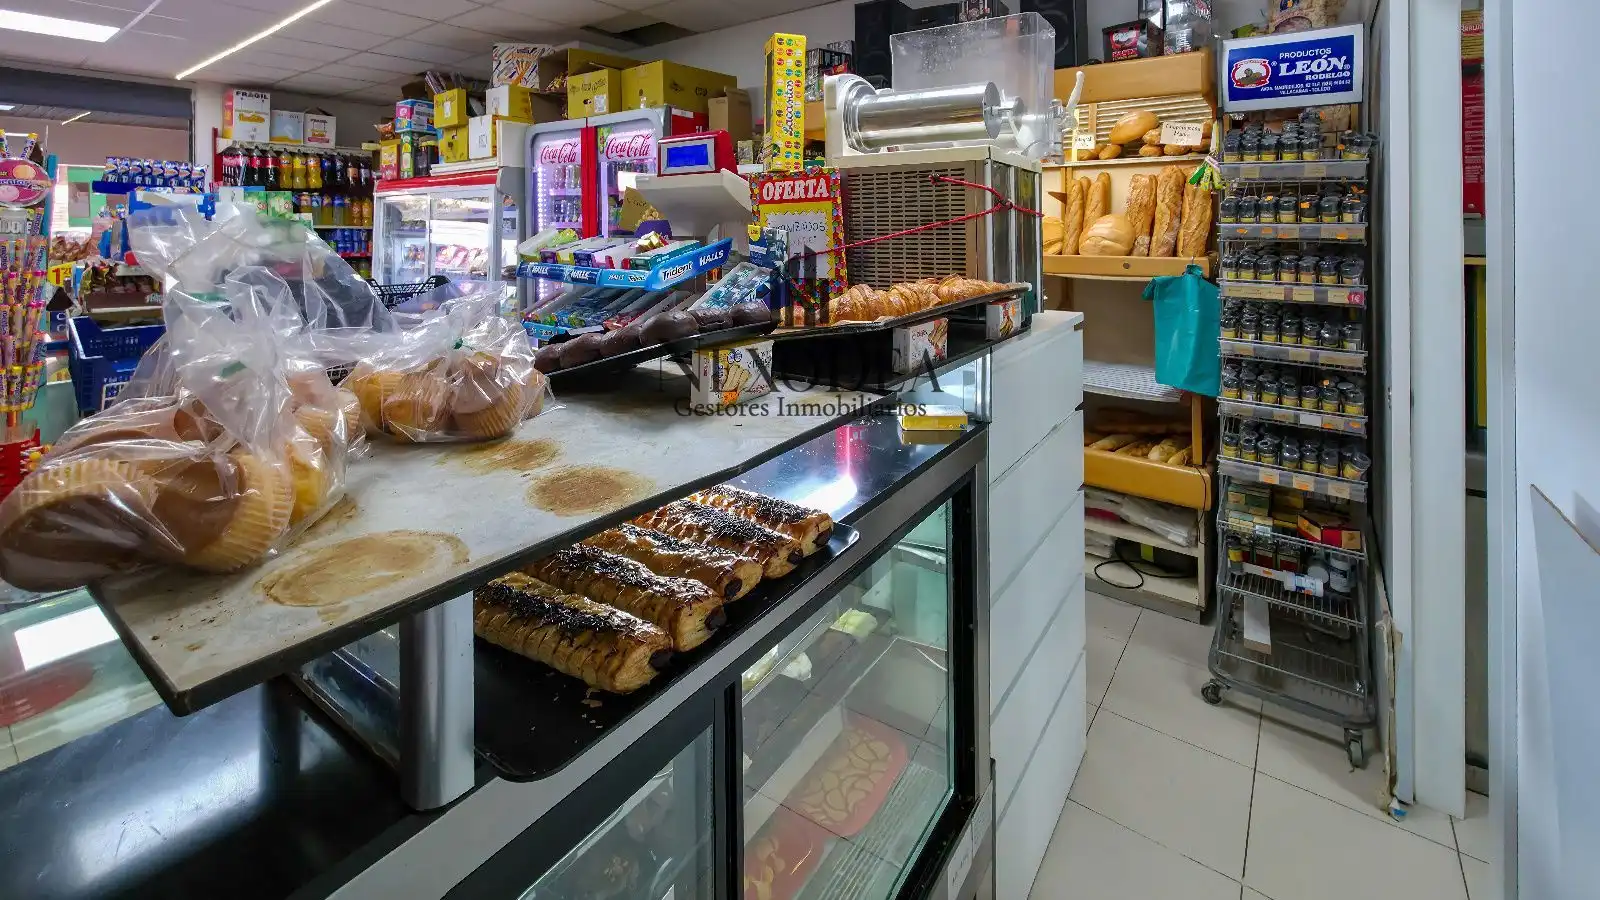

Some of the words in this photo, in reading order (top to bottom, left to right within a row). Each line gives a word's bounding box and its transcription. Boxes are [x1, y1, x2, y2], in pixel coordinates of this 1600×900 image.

[1279, 48, 1332, 59] PRODUCTOS
[1278, 55, 1347, 76] LEÓN
[762, 177, 829, 201] OFERTA
[662, 260, 694, 281] Trident
[699, 249, 725, 266] HALLS
